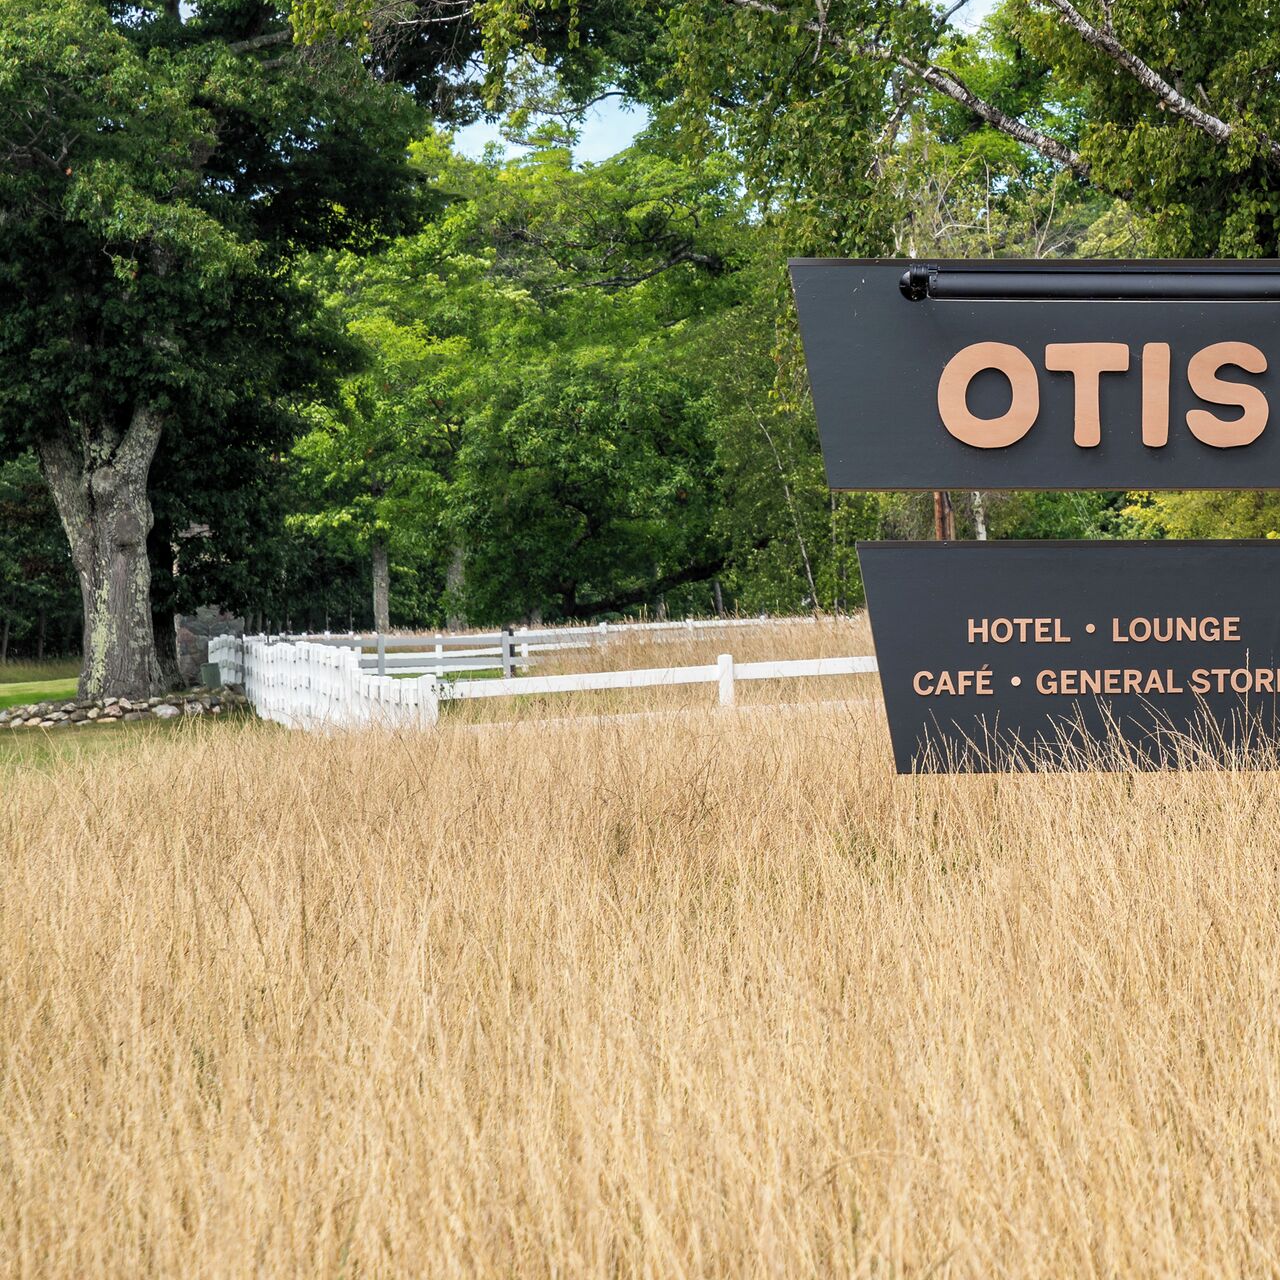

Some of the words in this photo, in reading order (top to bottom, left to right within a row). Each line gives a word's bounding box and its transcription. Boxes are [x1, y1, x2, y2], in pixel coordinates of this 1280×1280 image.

[937, 341, 1269, 448] OTIS
[967, 617, 1071, 643] HOTEL
[1112, 616, 1241, 642] LOUNGE
[912, 664, 994, 696] CAFÉ
[1035, 668, 1184, 695] GENERAL
